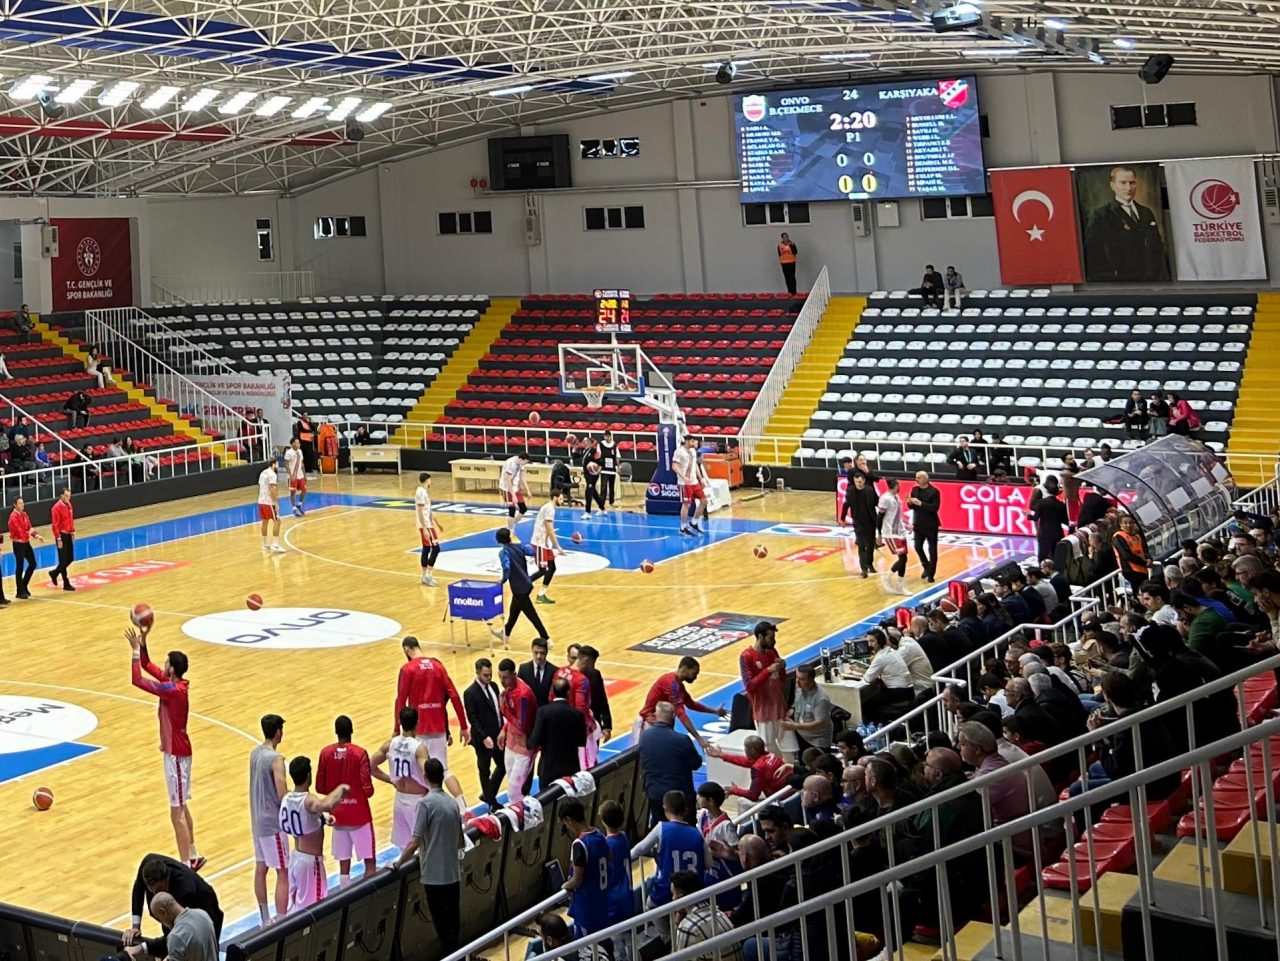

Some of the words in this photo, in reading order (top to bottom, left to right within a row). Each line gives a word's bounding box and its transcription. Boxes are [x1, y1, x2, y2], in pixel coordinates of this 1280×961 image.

[780, 96, 810, 106] ONVO
[843, 89, 859, 100] 24
[830, 111, 877, 131] 2:20
[846, 132, 861, 142] P1
[837, 154, 848, 167] 0
[863, 152, 875, 166] 0
[1192, 221, 1243, 231] TÜRKİYE
[1194, 230, 1245, 238] BASKETBOL
[66, 281, 77, 289] T.C.
[78, 278, 104, 289] GENÇLİK
[66, 291, 81, 300] SPOR
[82, 289, 113, 298] BAKANLIĞI
[598, 309, 616, 324] 24
[961, 485, 1025, 504] COLA
[453, 597, 484, 606] molten
[394, 758, 411, 778] 10
[281, 806, 303, 837] 20
[671, 850, 698, 875] 13
[598, 857, 608, 890] 8
